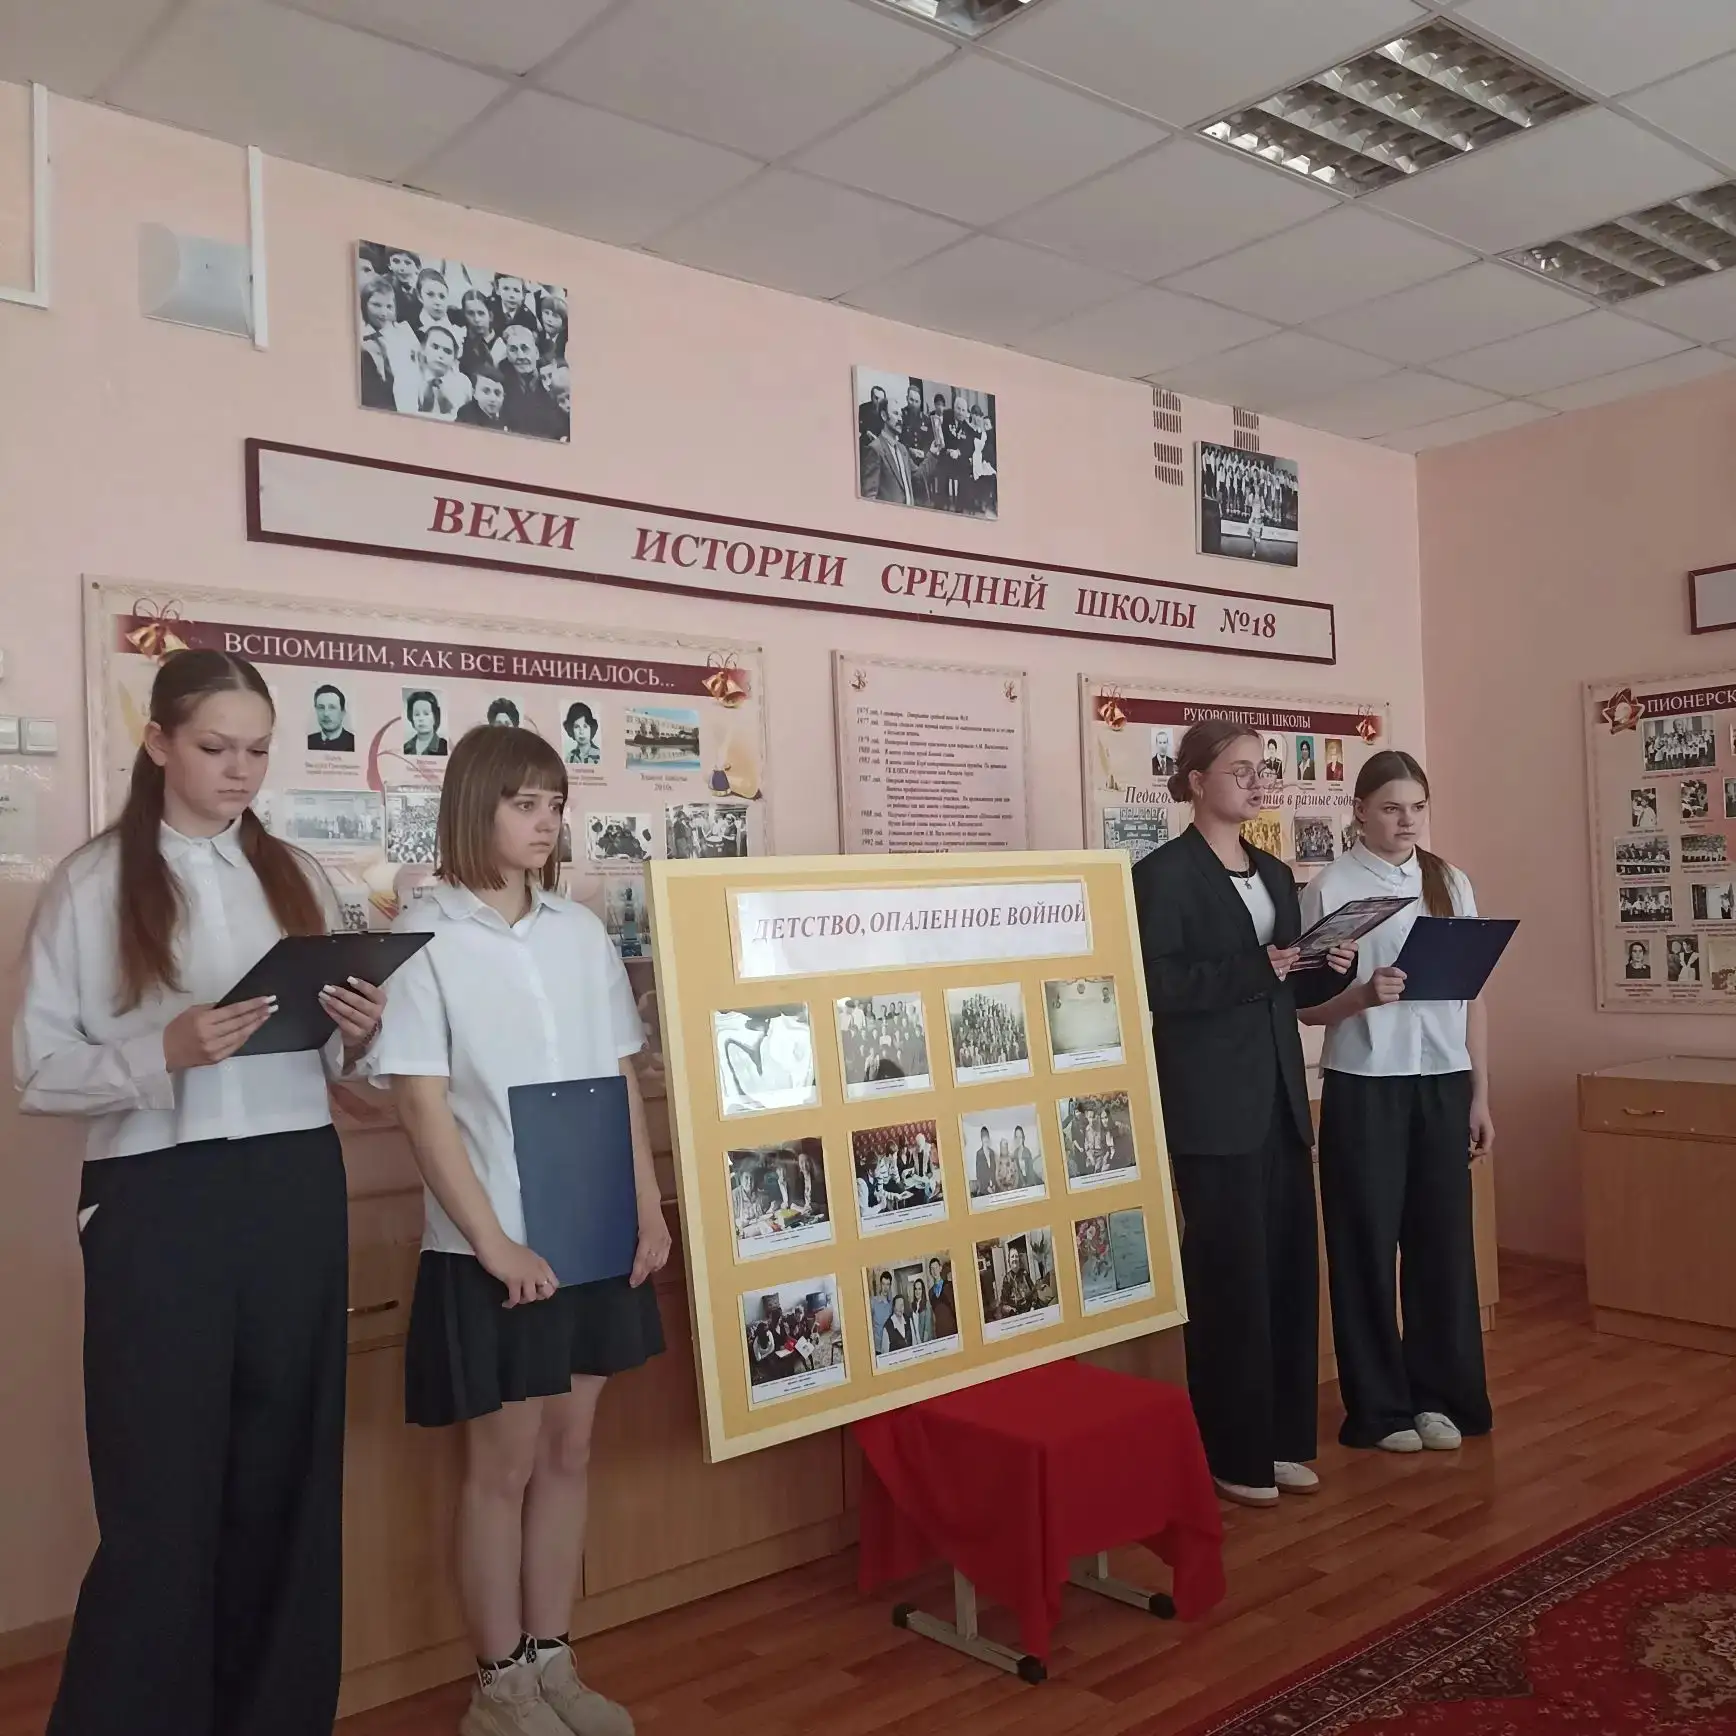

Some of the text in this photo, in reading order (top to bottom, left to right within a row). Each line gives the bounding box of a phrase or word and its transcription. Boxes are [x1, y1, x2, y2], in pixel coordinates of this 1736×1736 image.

[427, 496, 1277, 639] ВЕХИ ИСТОРИИ СРЕДНЕЙ ШКОЛЫ №18
[223, 631, 675, 688] ВСПОМНИМ, КАК ВСЕ НАЧИНАЛОСЬ...
[1271, 713, 1311, 729] ШКОЛЫ
[1294, 794, 1332, 810] разные
[752, 899, 1086, 943] ДЕТСТВО, ОПАЛЕННОЕ ВОЙНОЙ
